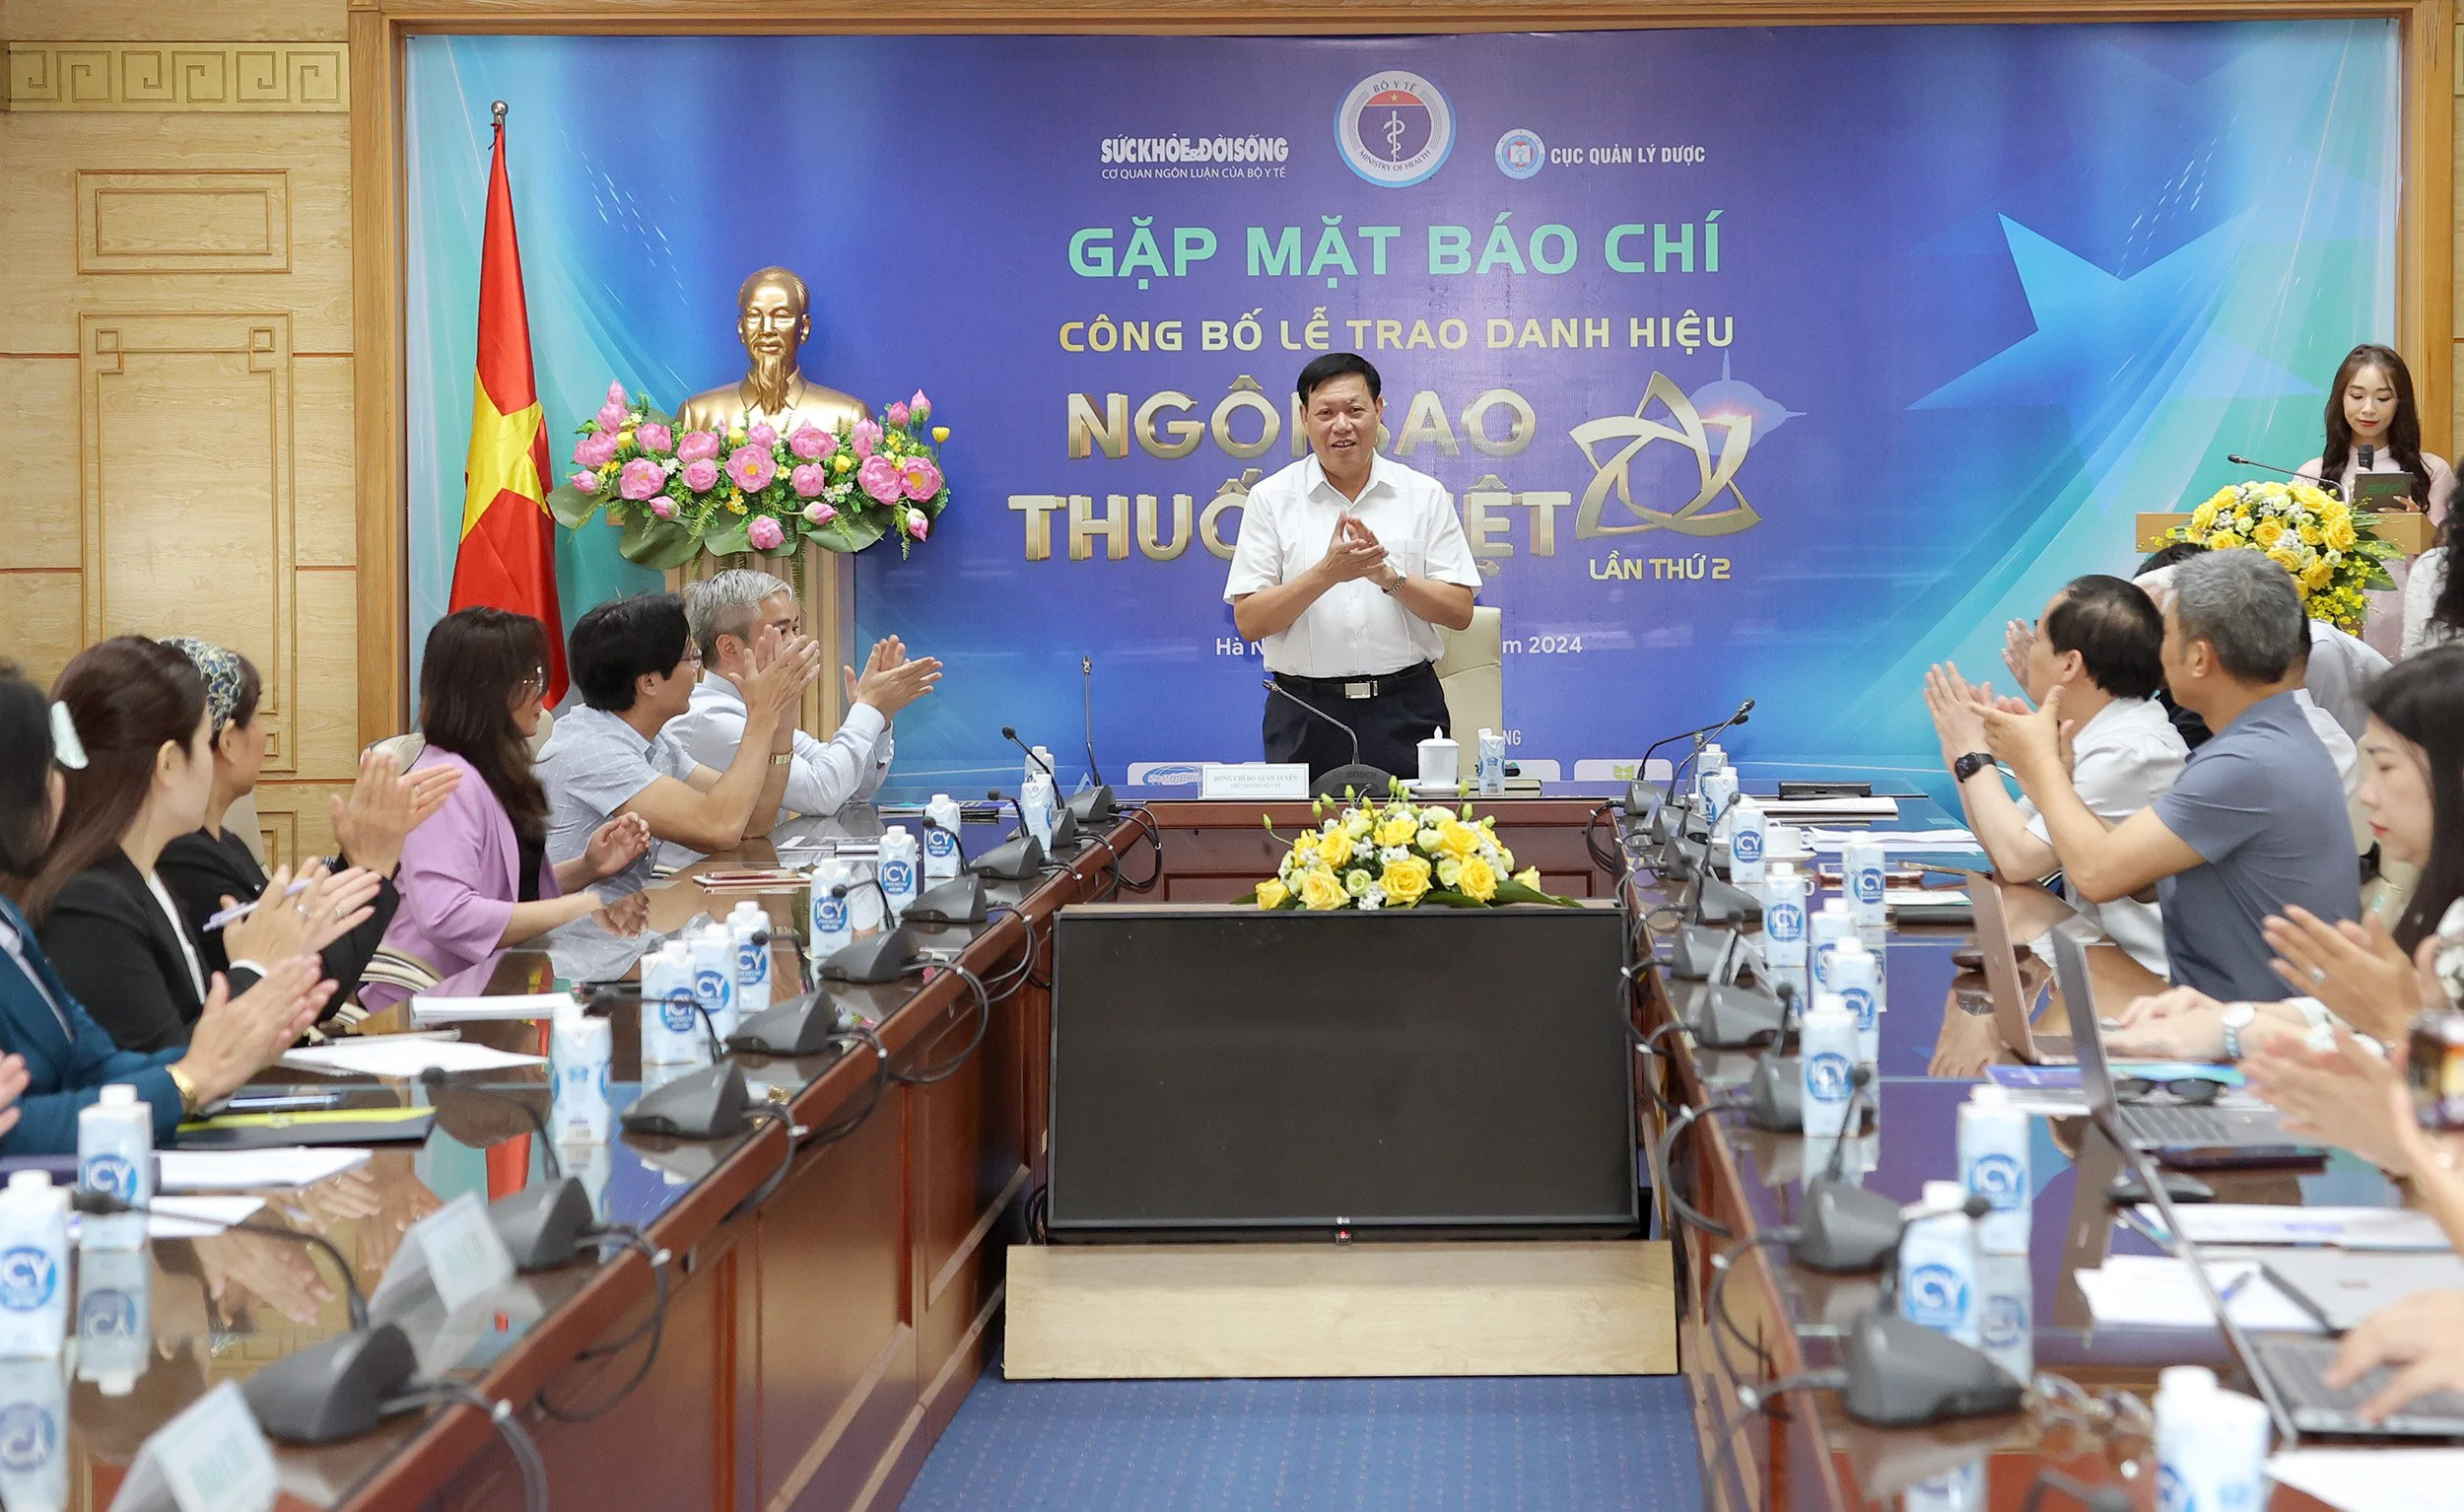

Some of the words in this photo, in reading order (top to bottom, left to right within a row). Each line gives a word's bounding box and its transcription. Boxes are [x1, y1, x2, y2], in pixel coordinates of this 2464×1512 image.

[1358, 150, 1391, 172] MINISTRY
[1404, 150, 1432, 171] HEALTH
[1550, 148, 1584, 167] CỤC
[1589, 143, 1632, 166] QUẢN
[1638, 144, 1657, 164] LÝ
[1661, 145, 1706, 166] DƯỢC
[1102, 168, 1119, 179] CƠ
[1120, 168, 1152, 179] QUAN
[1154, 167, 1188, 178] NGÔN
[1191, 167, 1219, 180] LUẬN
[1222, 166, 1245, 178] CỦA
[1247, 167, 1263, 180] BỘ
[1265, 168, 1271, 178] Y
[1272, 166, 1286, 178] TẾ
[1067, 215, 1218, 290] GẶP
[1247, 214, 1402, 289] MẶT
[1428, 211, 1578, 275] BÁO
[1604, 209, 1725, 273] CHÍ
[1059, 312, 1183, 352] CÔNG
[1201, 308, 1264, 351] BỐ
[1280, 306, 1330, 351] LỄ
[1346, 318, 1469, 351] TRAO
[1486, 316, 1609, 349] DANH
[1629, 309, 1734, 355] HIỆU
[1067, 375, 1310, 459] NGÔI
[1007, 468, 1263, 561] THUỐ
[1463, 474, 1572, 577] ỆT
[1589, 550, 1644, 580] LẦN
[1648, 553, 1708, 581] THỨ
[1711, 558, 1731, 580] 2
[1216, 637, 1245, 655] Hà
[1529, 636, 1583, 654] 2024
[928, 831, 950, 846] ICY
[1737, 836, 1760, 851] ICY
[884, 866, 909, 882] ICY
[1858, 874, 1883, 891] ICY
[817, 902, 844, 919] ICY
[1771, 910, 1801, 928] ICY
[738, 950, 764, 970] CY
[696, 976, 726, 998] CY
[85, 1161, 131, 1193] ICY
[3, 1252, 51, 1287] CY
